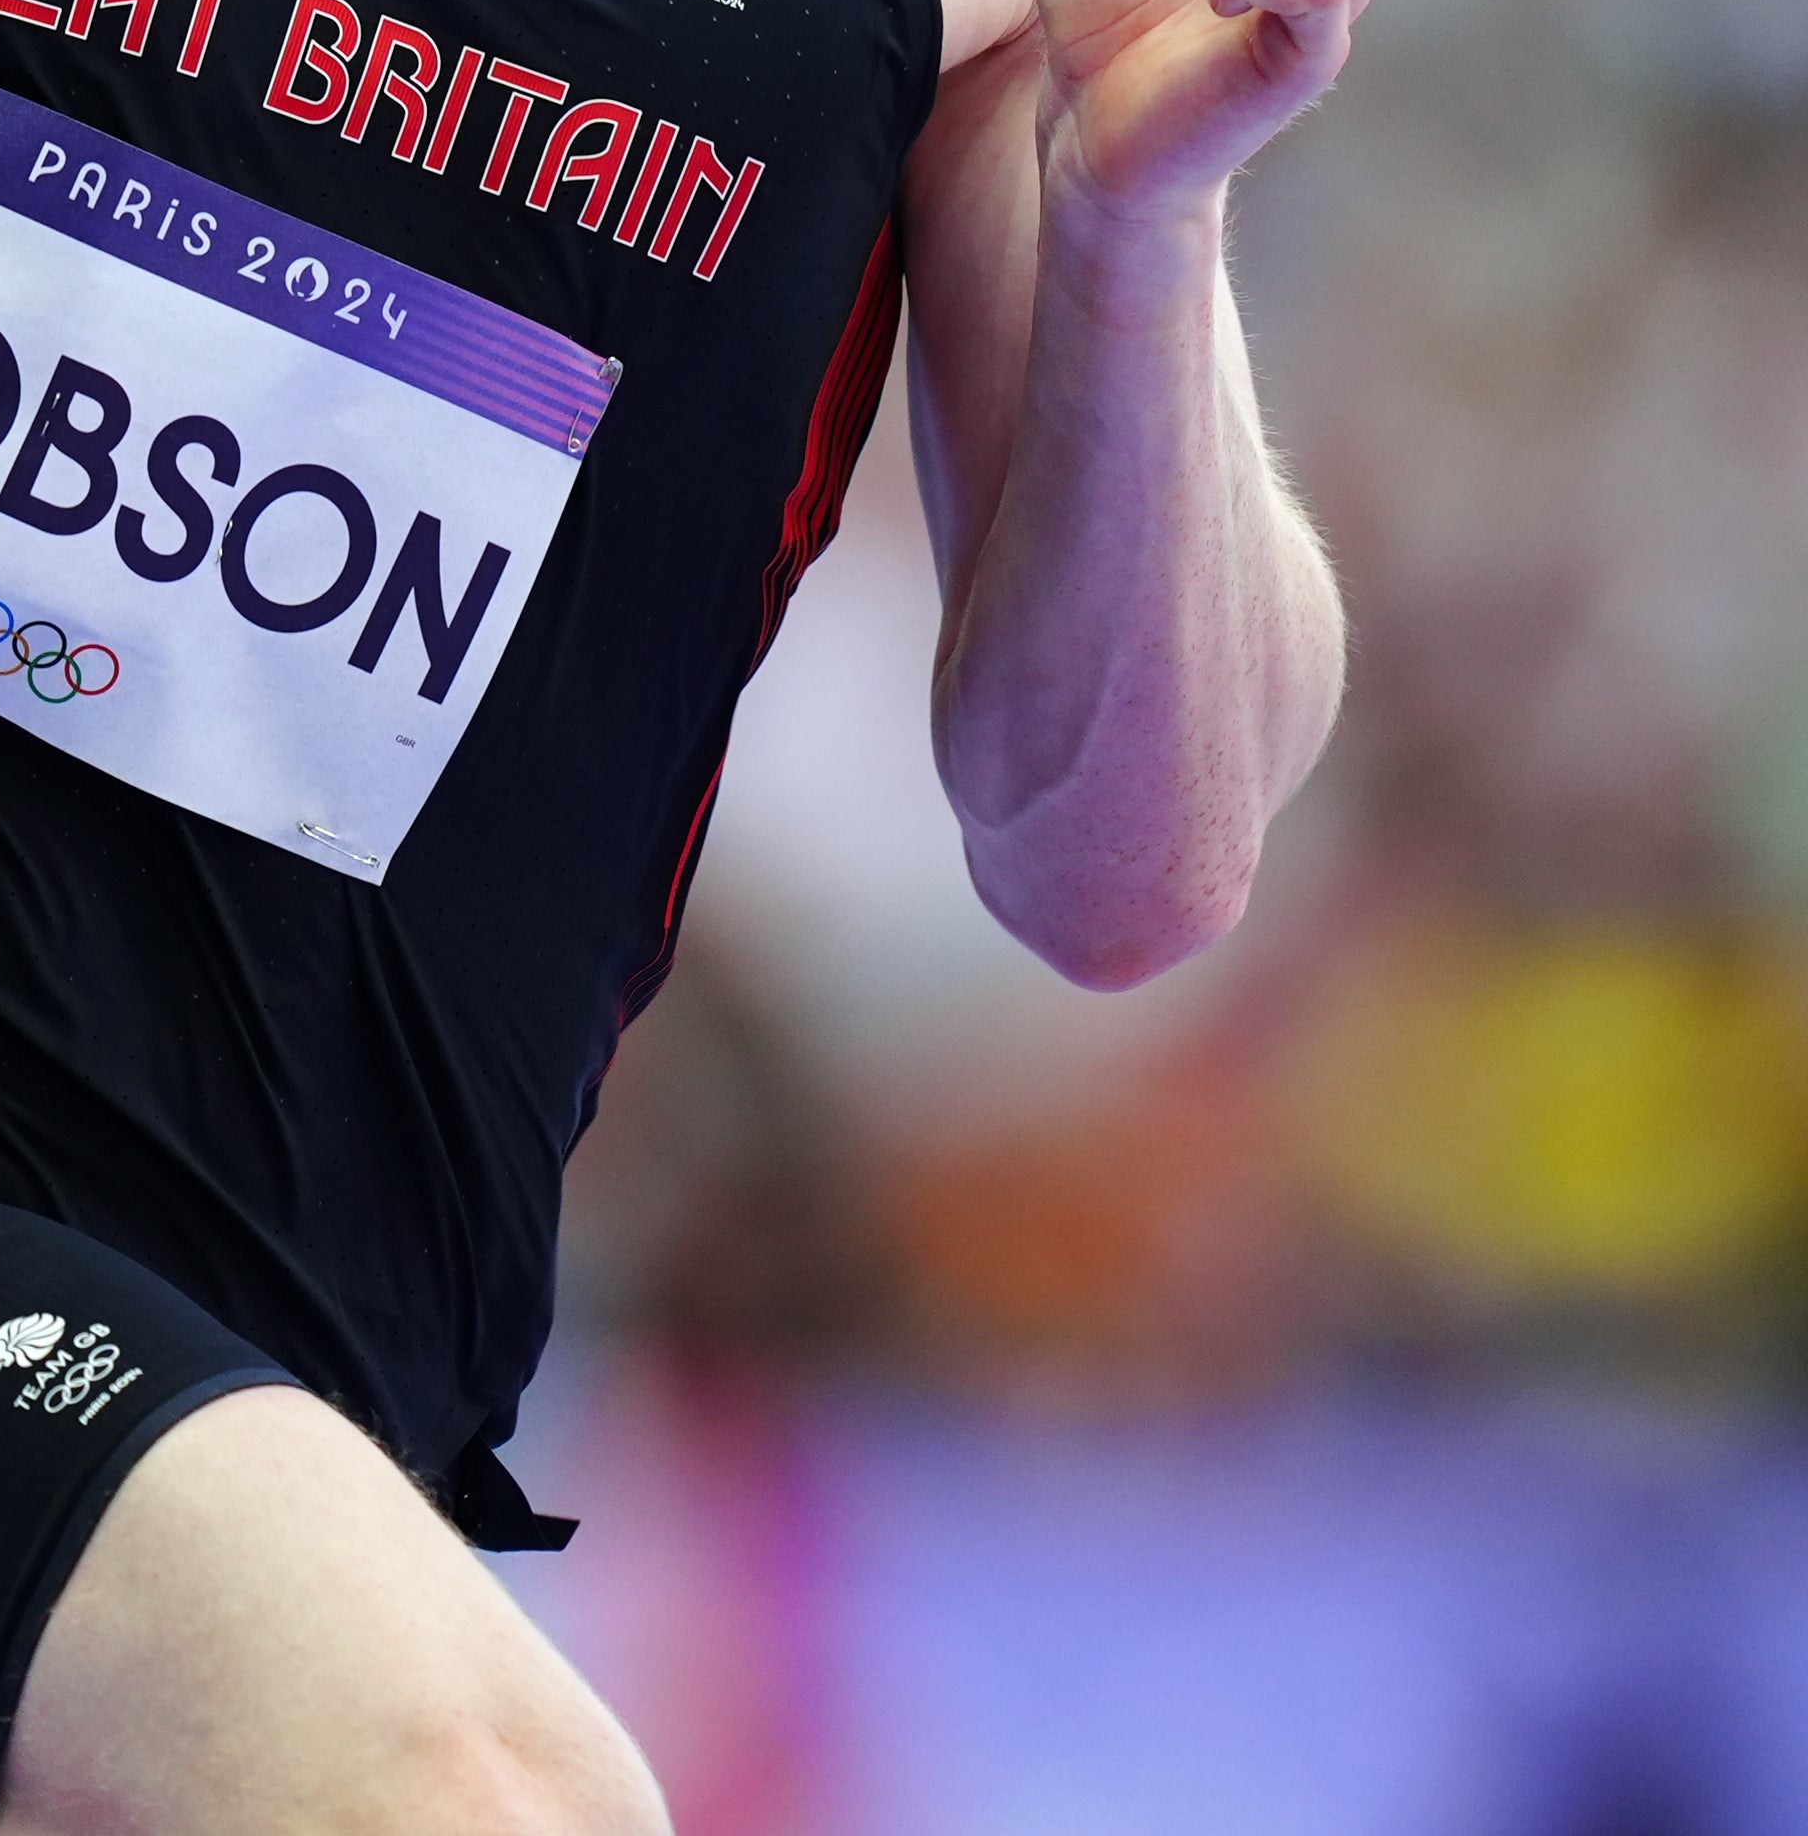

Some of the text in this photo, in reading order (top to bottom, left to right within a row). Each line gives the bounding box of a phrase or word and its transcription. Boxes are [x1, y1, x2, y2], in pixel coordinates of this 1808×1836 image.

[237, 237, 408, 340] 2024
[395, 734, 416, 749] GBR
[13, 1322, 111, 1411] TEAM GB
